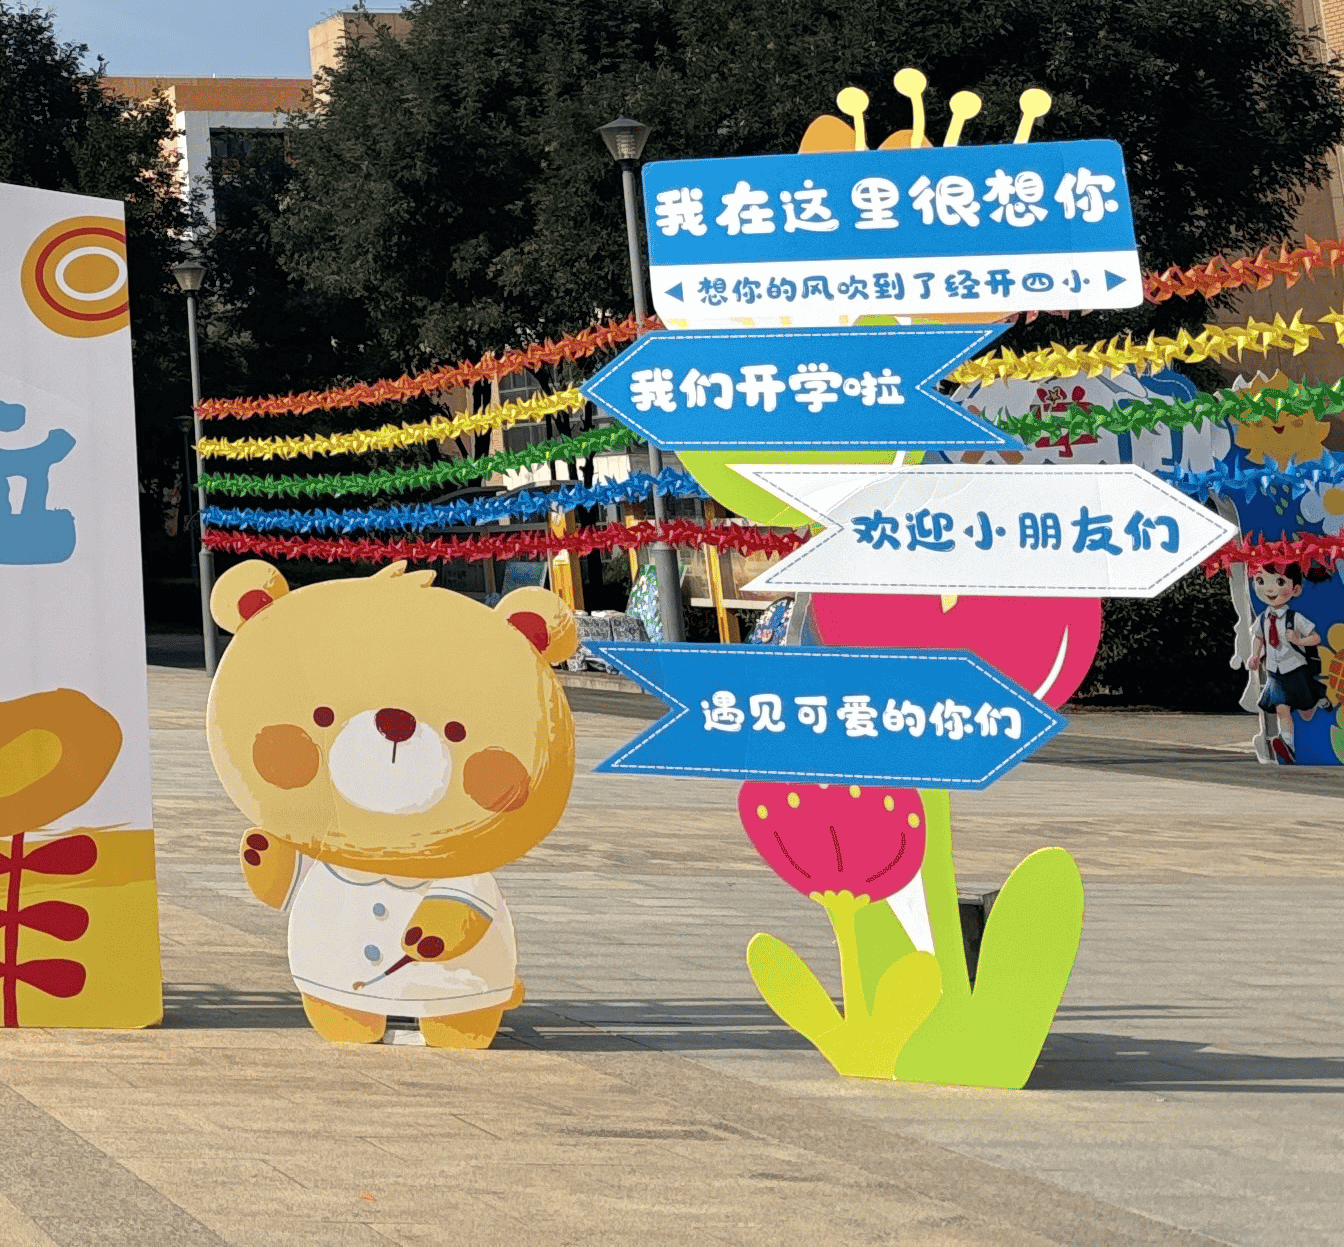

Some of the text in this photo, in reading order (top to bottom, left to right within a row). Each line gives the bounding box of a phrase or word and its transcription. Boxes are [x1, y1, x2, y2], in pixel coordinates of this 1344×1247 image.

[655, 169, 1118, 236] 我在这里很想你
[698, 269, 1089, 306] 想你的风吹到了经开四小
[631, 363, 904, 412] 我们开学啦
[852, 508, 1181, 556] 欢迎小朋友们
[703, 691, 1021, 740] 遇见可爱的你们
